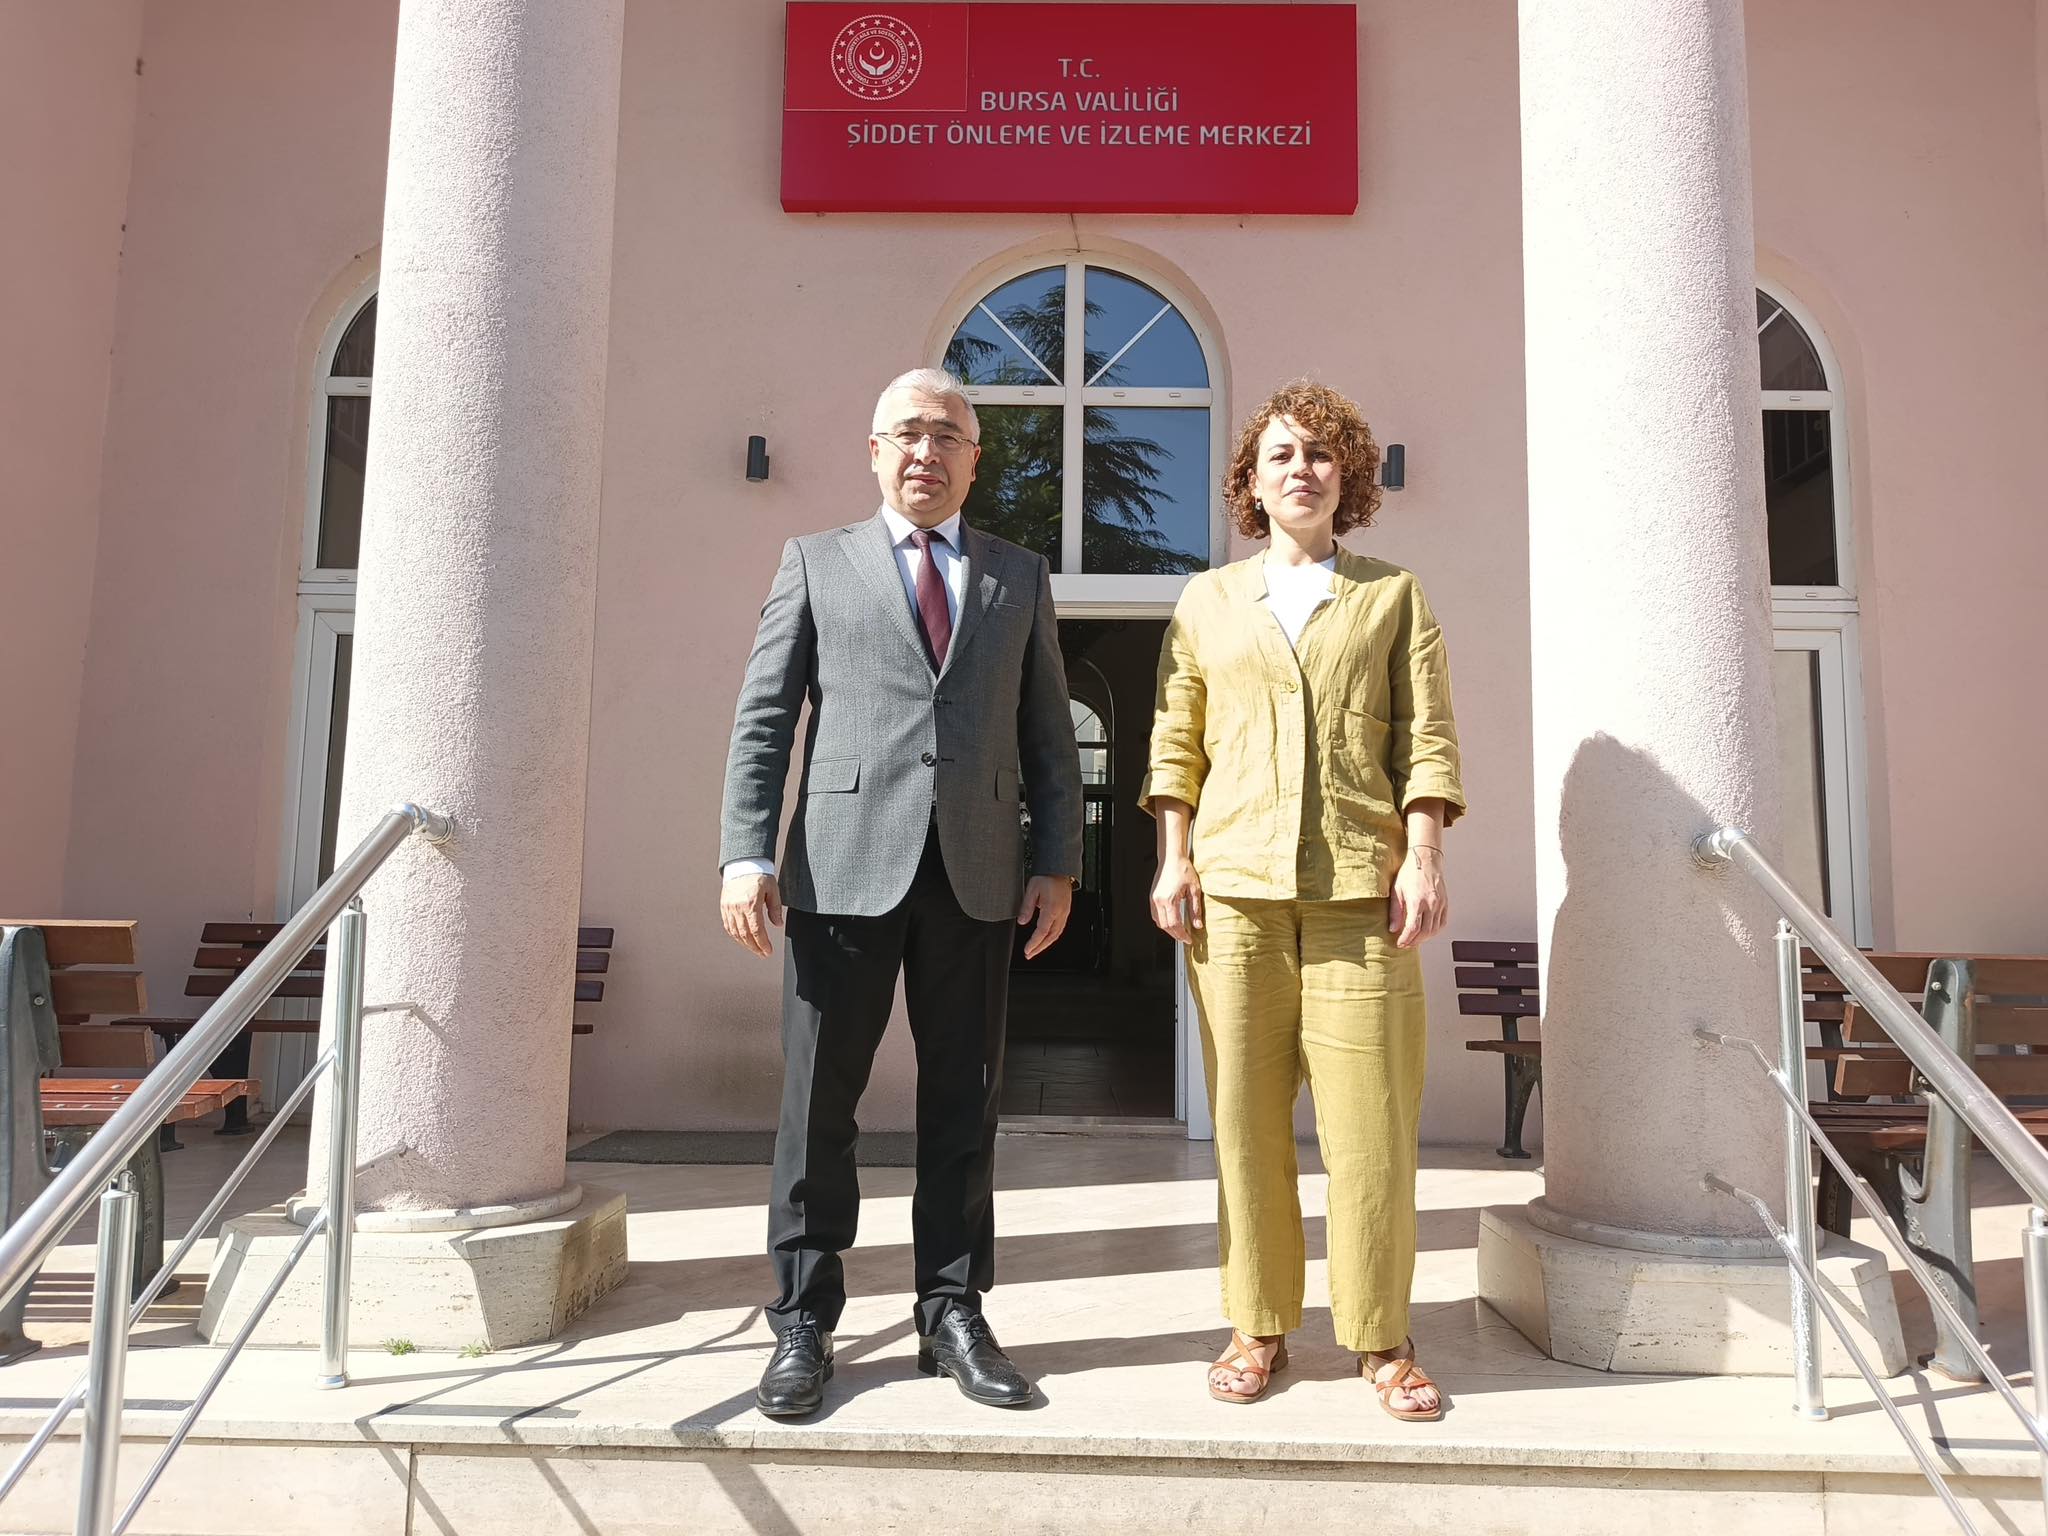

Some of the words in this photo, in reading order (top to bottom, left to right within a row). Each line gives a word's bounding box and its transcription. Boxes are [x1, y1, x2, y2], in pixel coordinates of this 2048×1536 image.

[1058, 58, 1101, 78] T.C.
[981, 91, 1067, 111] BURSA
[1075, 87, 1178, 111] VALİLİĞİ
[847, 120, 938, 148] ŞİDDET
[946, 120, 1051, 145] ÖNLEME
[1060, 125, 1091, 145] VE
[1100, 120, 1190, 145] İZLEME
[1199, 120, 1311, 146] MERKEZİ
